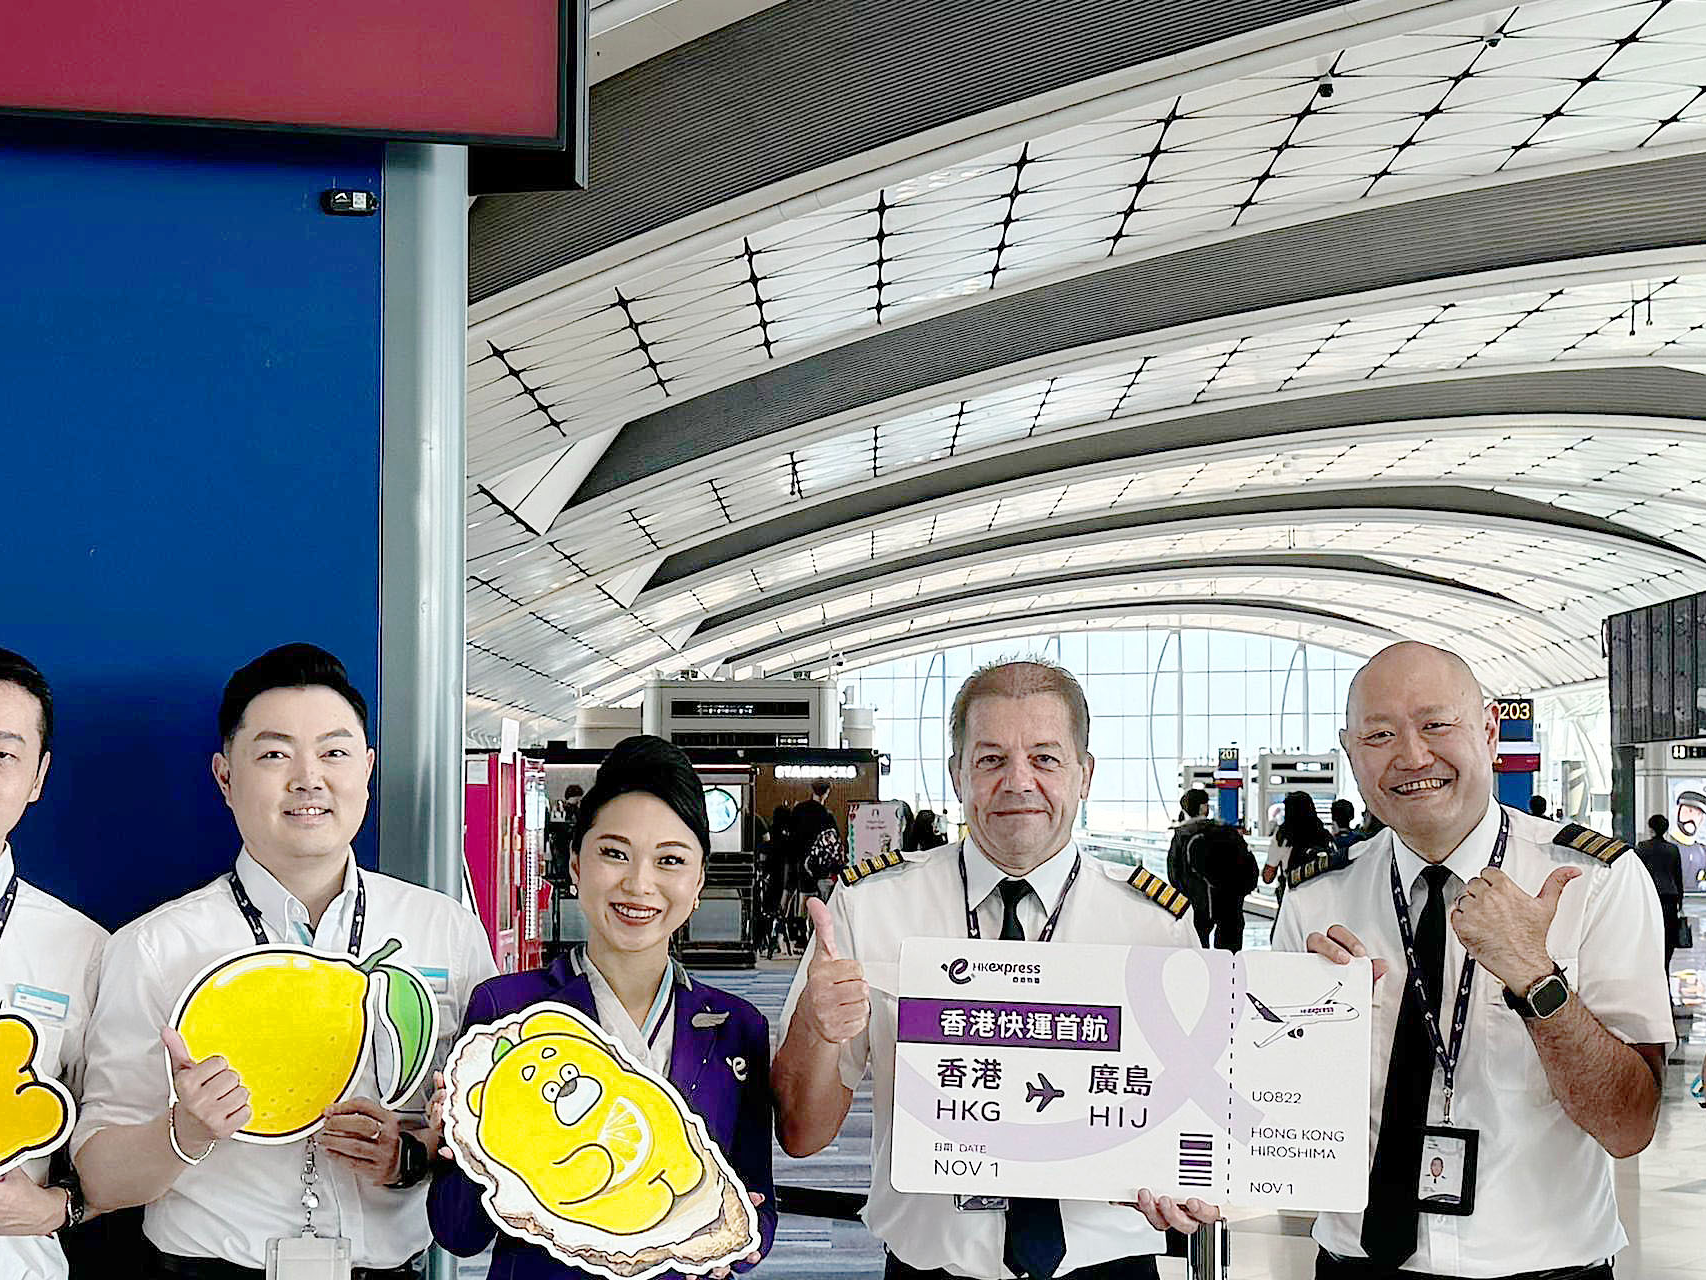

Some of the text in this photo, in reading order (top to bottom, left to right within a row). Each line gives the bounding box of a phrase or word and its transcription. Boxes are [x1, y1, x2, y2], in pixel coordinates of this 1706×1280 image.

[1500, 702, 1530, 720] 203
[774, 764, 858, 779] STARBUCKS
[972, 962, 1041, 975] HKexpress
[940, 1008, 1109, 1042] 香港快運首航
[937, 1058, 1002, 1090] 香港
[1088, 1063, 1153, 1097] 廣島
[1252, 1090, 1302, 1104] UO822
[936, 1099, 1001, 1122] HKG
[1089, 1105, 1148, 1129] HIJ
[1251, 1127, 1345, 1143] HONG KONG
[959, 1143, 987, 1154] DATE
[1250, 1145, 1336, 1160] HIROSHIMA
[934, 1159, 999, 1178] NOV 1
[1250, 1182, 1283, 1194] NOV
